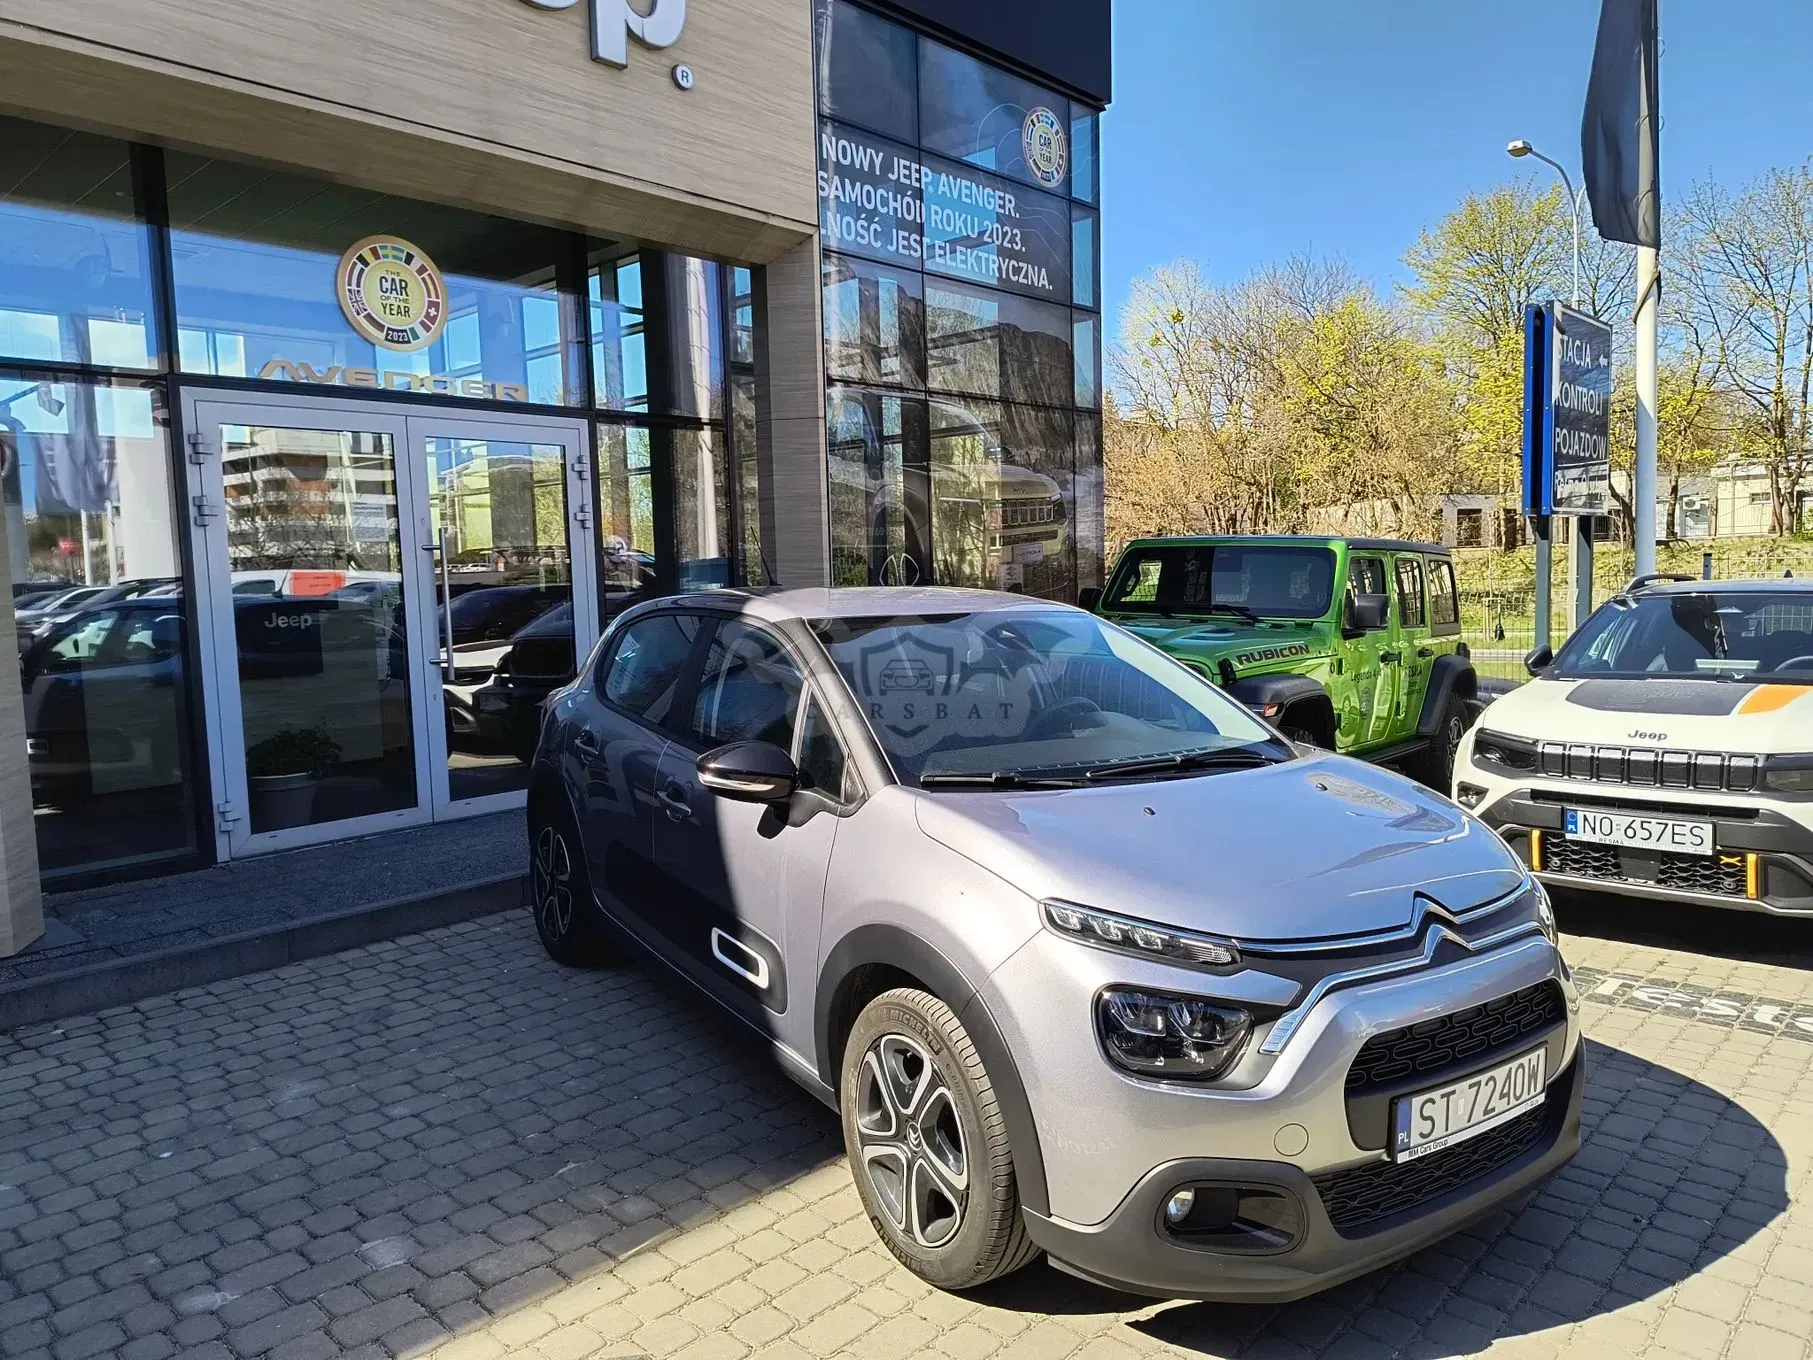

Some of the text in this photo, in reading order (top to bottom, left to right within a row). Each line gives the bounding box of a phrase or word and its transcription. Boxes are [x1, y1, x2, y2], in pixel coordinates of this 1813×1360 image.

[1038, 134, 1052, 150] CAR
[1039, 153, 1052, 164] YEAR
[822, 133, 883, 175] NOWY
[938, 173, 1020, 219] AVENGER.
[818, 171, 1026, 252] SAMOCHÓD ROKU 2023.
[820, 210, 1053, 290] NOŚĆ JEST ELEKTRYCZNA.
[385, 269, 401, 277] THE
[379, 276, 410, 297] CAR
[381, 301, 411, 318] YEAR
[393, 296, 410, 305] THE
[387, 330, 409, 341] 2023
[258, 360, 528, 401] AVENGER
[1555, 381, 1603, 416] KONTROLI
[1555, 427, 1607, 459] POJAZDÓW
[264, 612, 312, 629] Jeep
[1236, 643, 1310, 666] RUBICON
[1628, 729, 1668, 742] Jeep
[1582, 813, 1613, 837] NO
[1624, 818, 1705, 847] 657ES
[889, 1009, 941, 1056] MICHELIN
[1398, 1054, 1540, 1145] PL ST 7240W
[1420, 1144, 1432, 1155] Cars
[1432, 1139, 1449, 1151] Group
